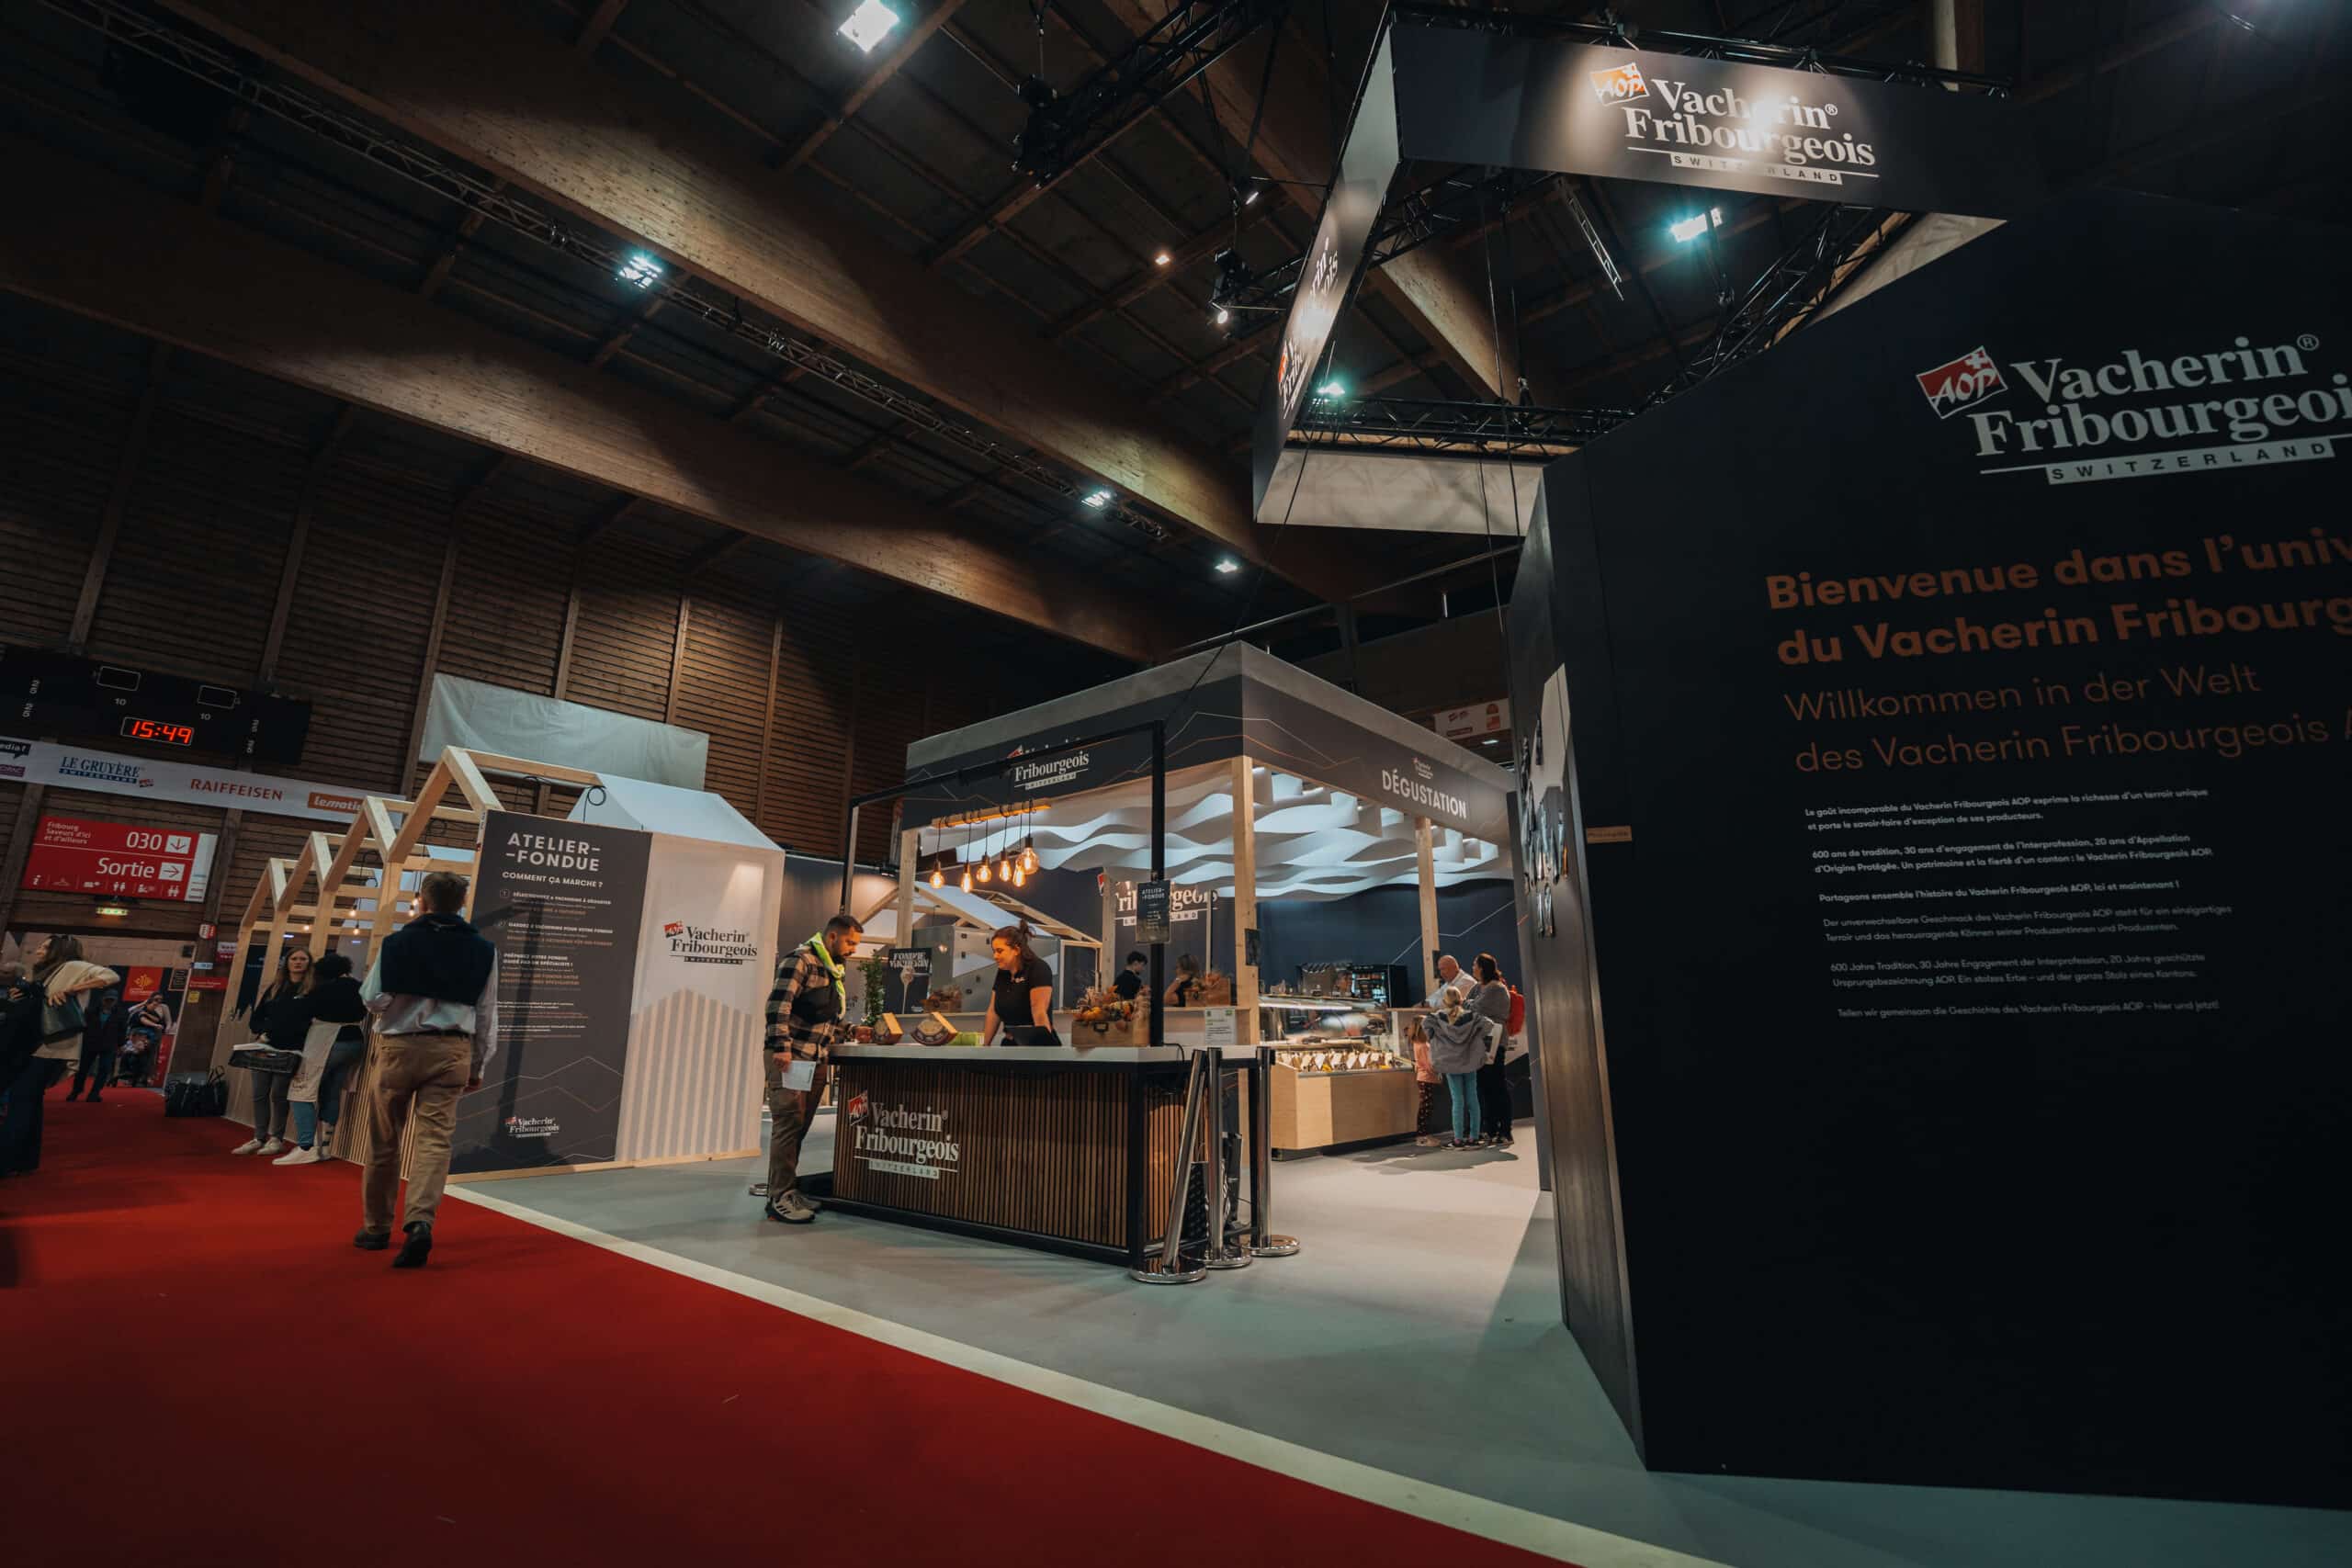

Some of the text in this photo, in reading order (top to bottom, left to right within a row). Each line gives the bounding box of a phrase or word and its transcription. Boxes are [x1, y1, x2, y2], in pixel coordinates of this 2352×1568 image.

[1932, 369, 1996, 407] AOP
[2052, 443, 2324, 480] SWITZERLAND
[1765, 559, 2039, 610] Bienvenue
[2053, 547, 2191, 586] dans
[1777, 629, 1844, 666] du
[1853, 607, 2099, 660] Vacherin
[1783, 661, 2263, 722] Willkommen in der Welt
[132, 720, 192, 744] 15:49
[1794, 742, 1864, 773] des
[1871, 729, 2051, 766] Vacherin
[2061, 713, 2329, 759] Fribourgeois
[62, 757, 141, 777] LE GRUYÈRE
[1014, 750, 1090, 782] Fribourgeois
[191, 778, 283, 801] RAIFFEISEN
[1382, 769, 1467, 819] DÉGUSTATION
[126, 831, 162, 851] 030
[96, 857, 155, 879] Sortie
[503, 872, 548, 883] COMMENT
[548, 876, 560, 886] ÇA
[562, 878, 597, 888] MARCHE
[671, 938, 758, 957] Fribourgeois
[686, 926, 746, 943] Vacherin
[509, 1122, 560, 1134] Fribourgeois
[872, 1102, 943, 1133] Vacherin
[854, 1125, 960, 1164] Fribourgeois
